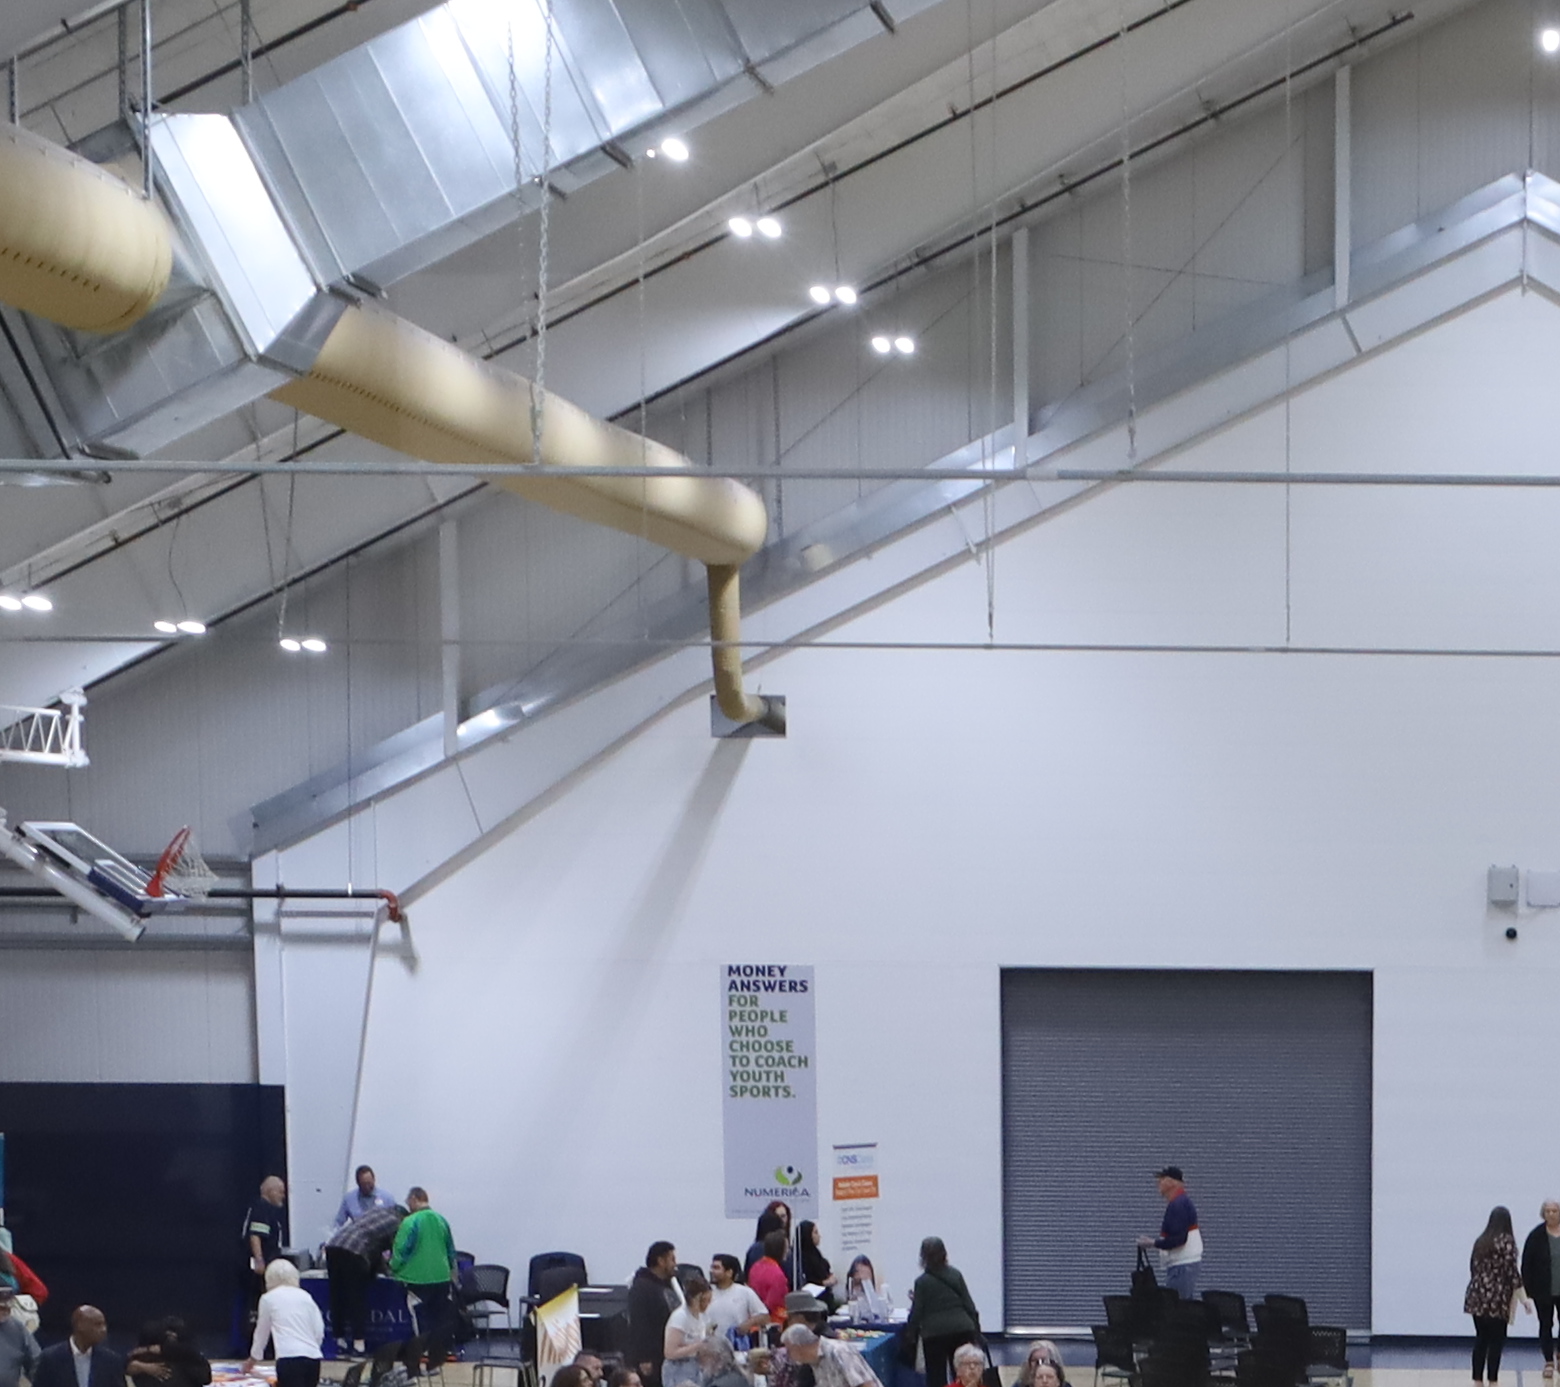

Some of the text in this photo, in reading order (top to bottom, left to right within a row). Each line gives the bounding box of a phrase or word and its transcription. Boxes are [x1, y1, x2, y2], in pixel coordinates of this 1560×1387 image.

[728, 965, 787, 977] MONEY
[728, 980, 808, 993] ANSWERS
[728, 995, 759, 1007] FOR
[728, 1010, 788, 1023] PEOPLE
[728, 1025, 768, 1038] WHO
[729, 1040, 794, 1053] CHOOSE
[729, 1055, 809, 1068] TO COACH
[730, 1070, 785, 1083] YOUTH
[729, 1085, 796, 1098] SPORTS.
[744, 1187, 810, 1198] NUMERICA
